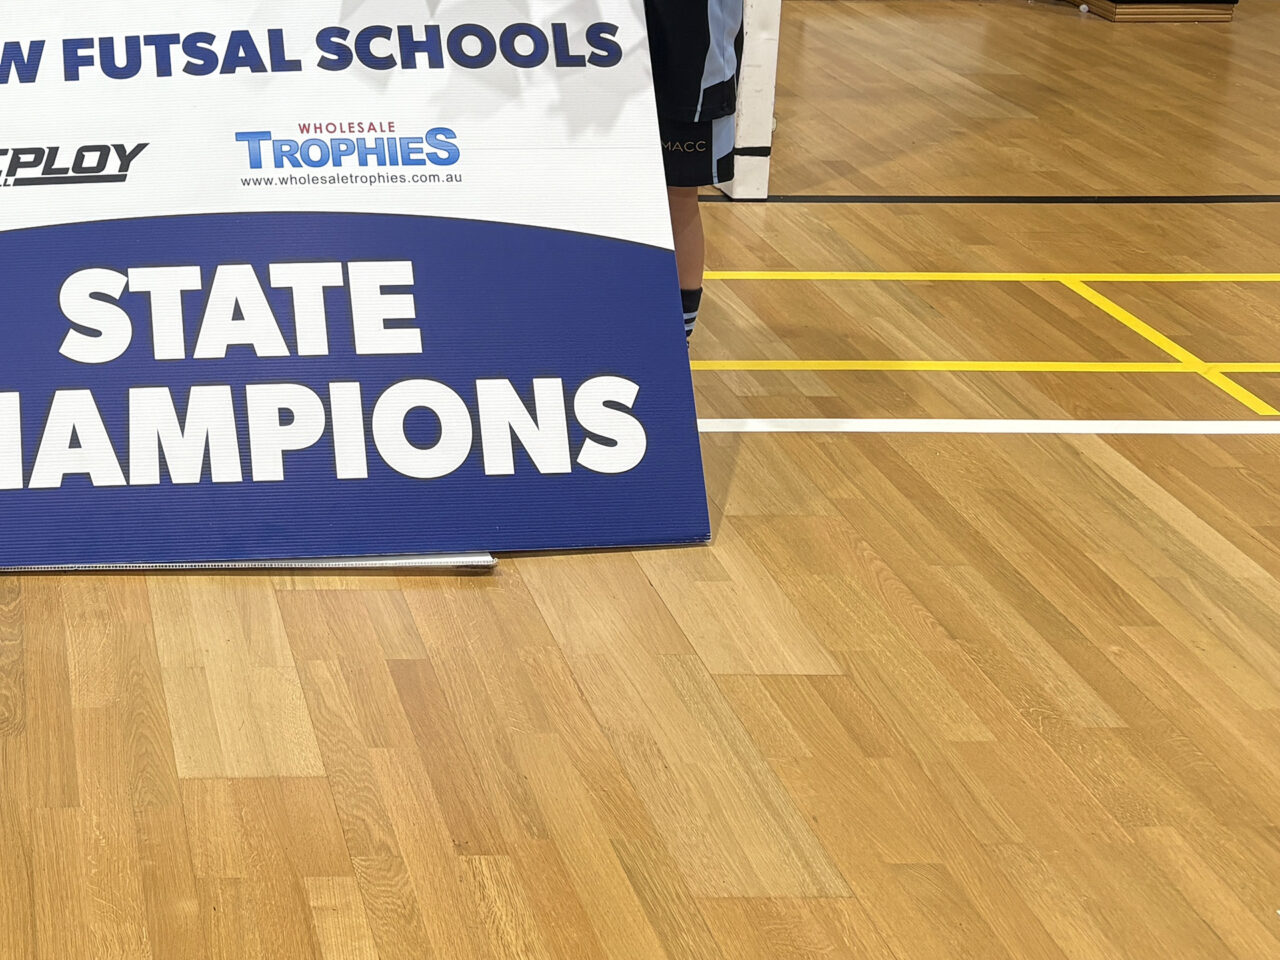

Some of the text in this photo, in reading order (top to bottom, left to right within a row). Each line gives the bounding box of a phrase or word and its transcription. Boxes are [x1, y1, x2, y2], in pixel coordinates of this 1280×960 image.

[62, 28, 302, 81] FUTSAL
[316, 21, 623, 72] SCHOOLS
[298, 121, 396, 135] WHOLESALE
[661, 141, 707, 153] MACC
[241, 172, 463, 187] www.wholesaletrophies.com.au
[58, 259, 423, 365] STATE
